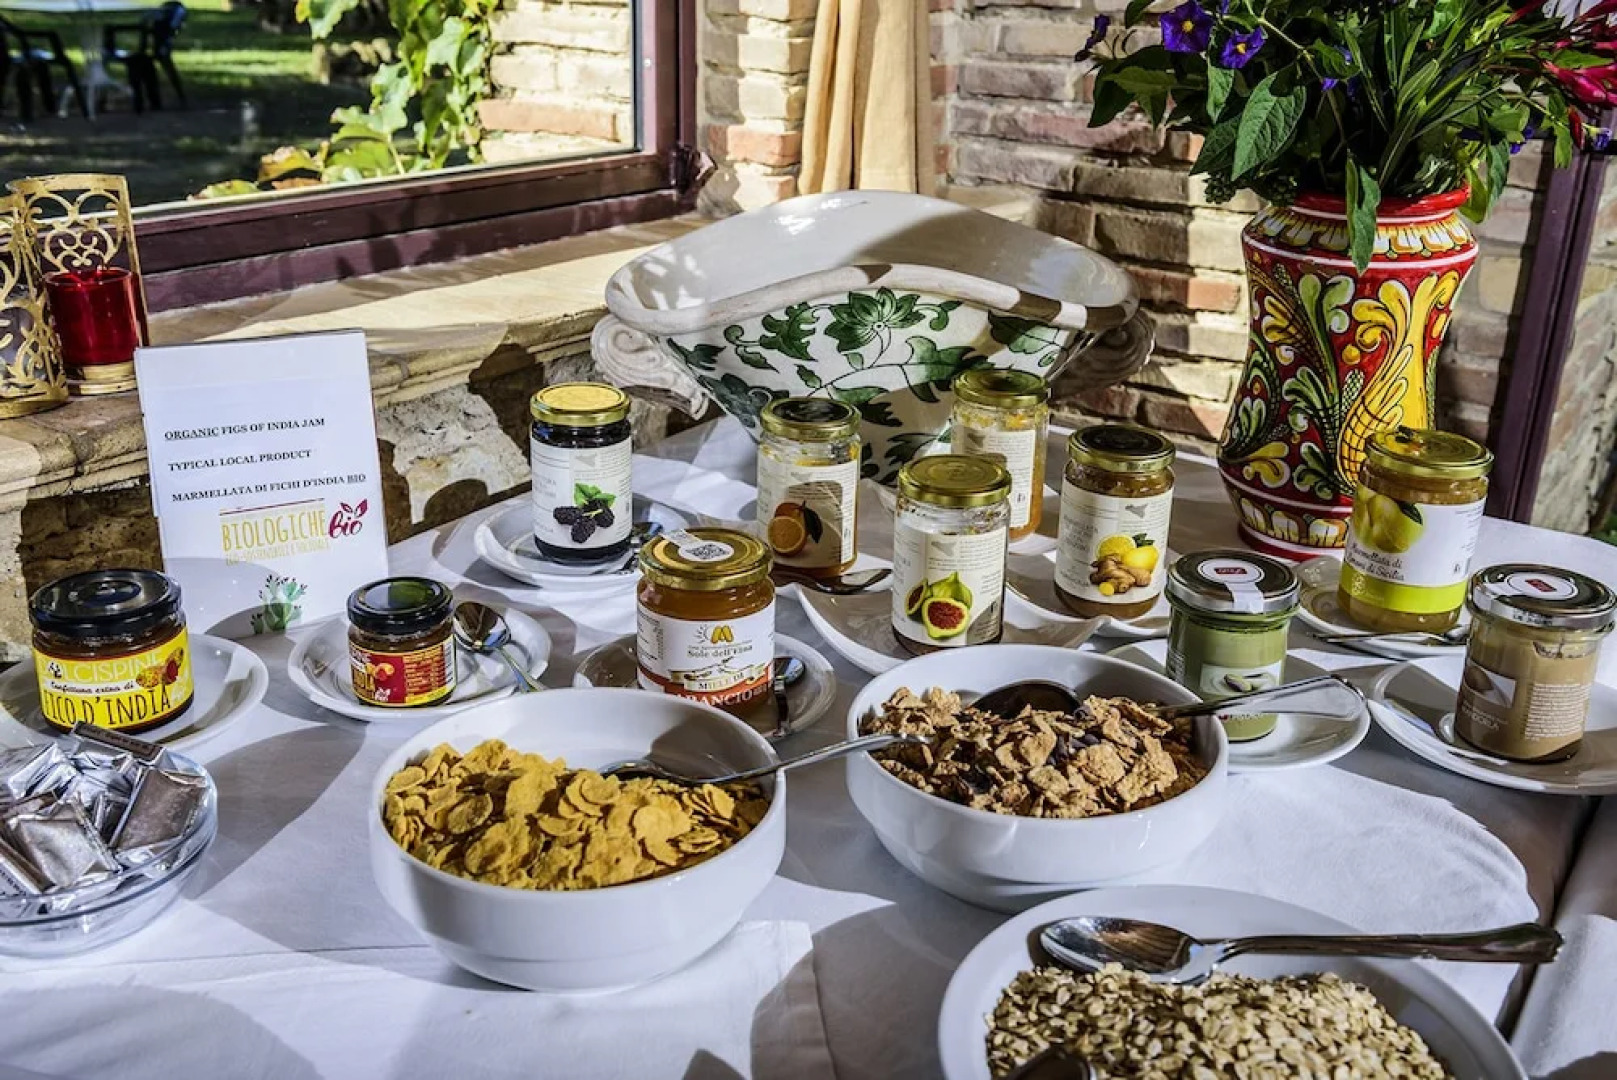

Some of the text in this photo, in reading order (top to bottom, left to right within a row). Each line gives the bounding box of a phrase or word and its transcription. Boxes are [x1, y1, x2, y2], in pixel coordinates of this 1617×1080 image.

[164, 418, 325, 441] ORGANIC FIGS OF INDIA JAM
[168, 449, 312, 472] TYPICAL LOCAL PRODUCT
[172, 473, 367, 502] MARMELLATA DI FICHI D'INDIA BIO
[222, 510, 328, 551] BIOLOGICHE
[43, 685, 171, 725] FICO D'INDIA
